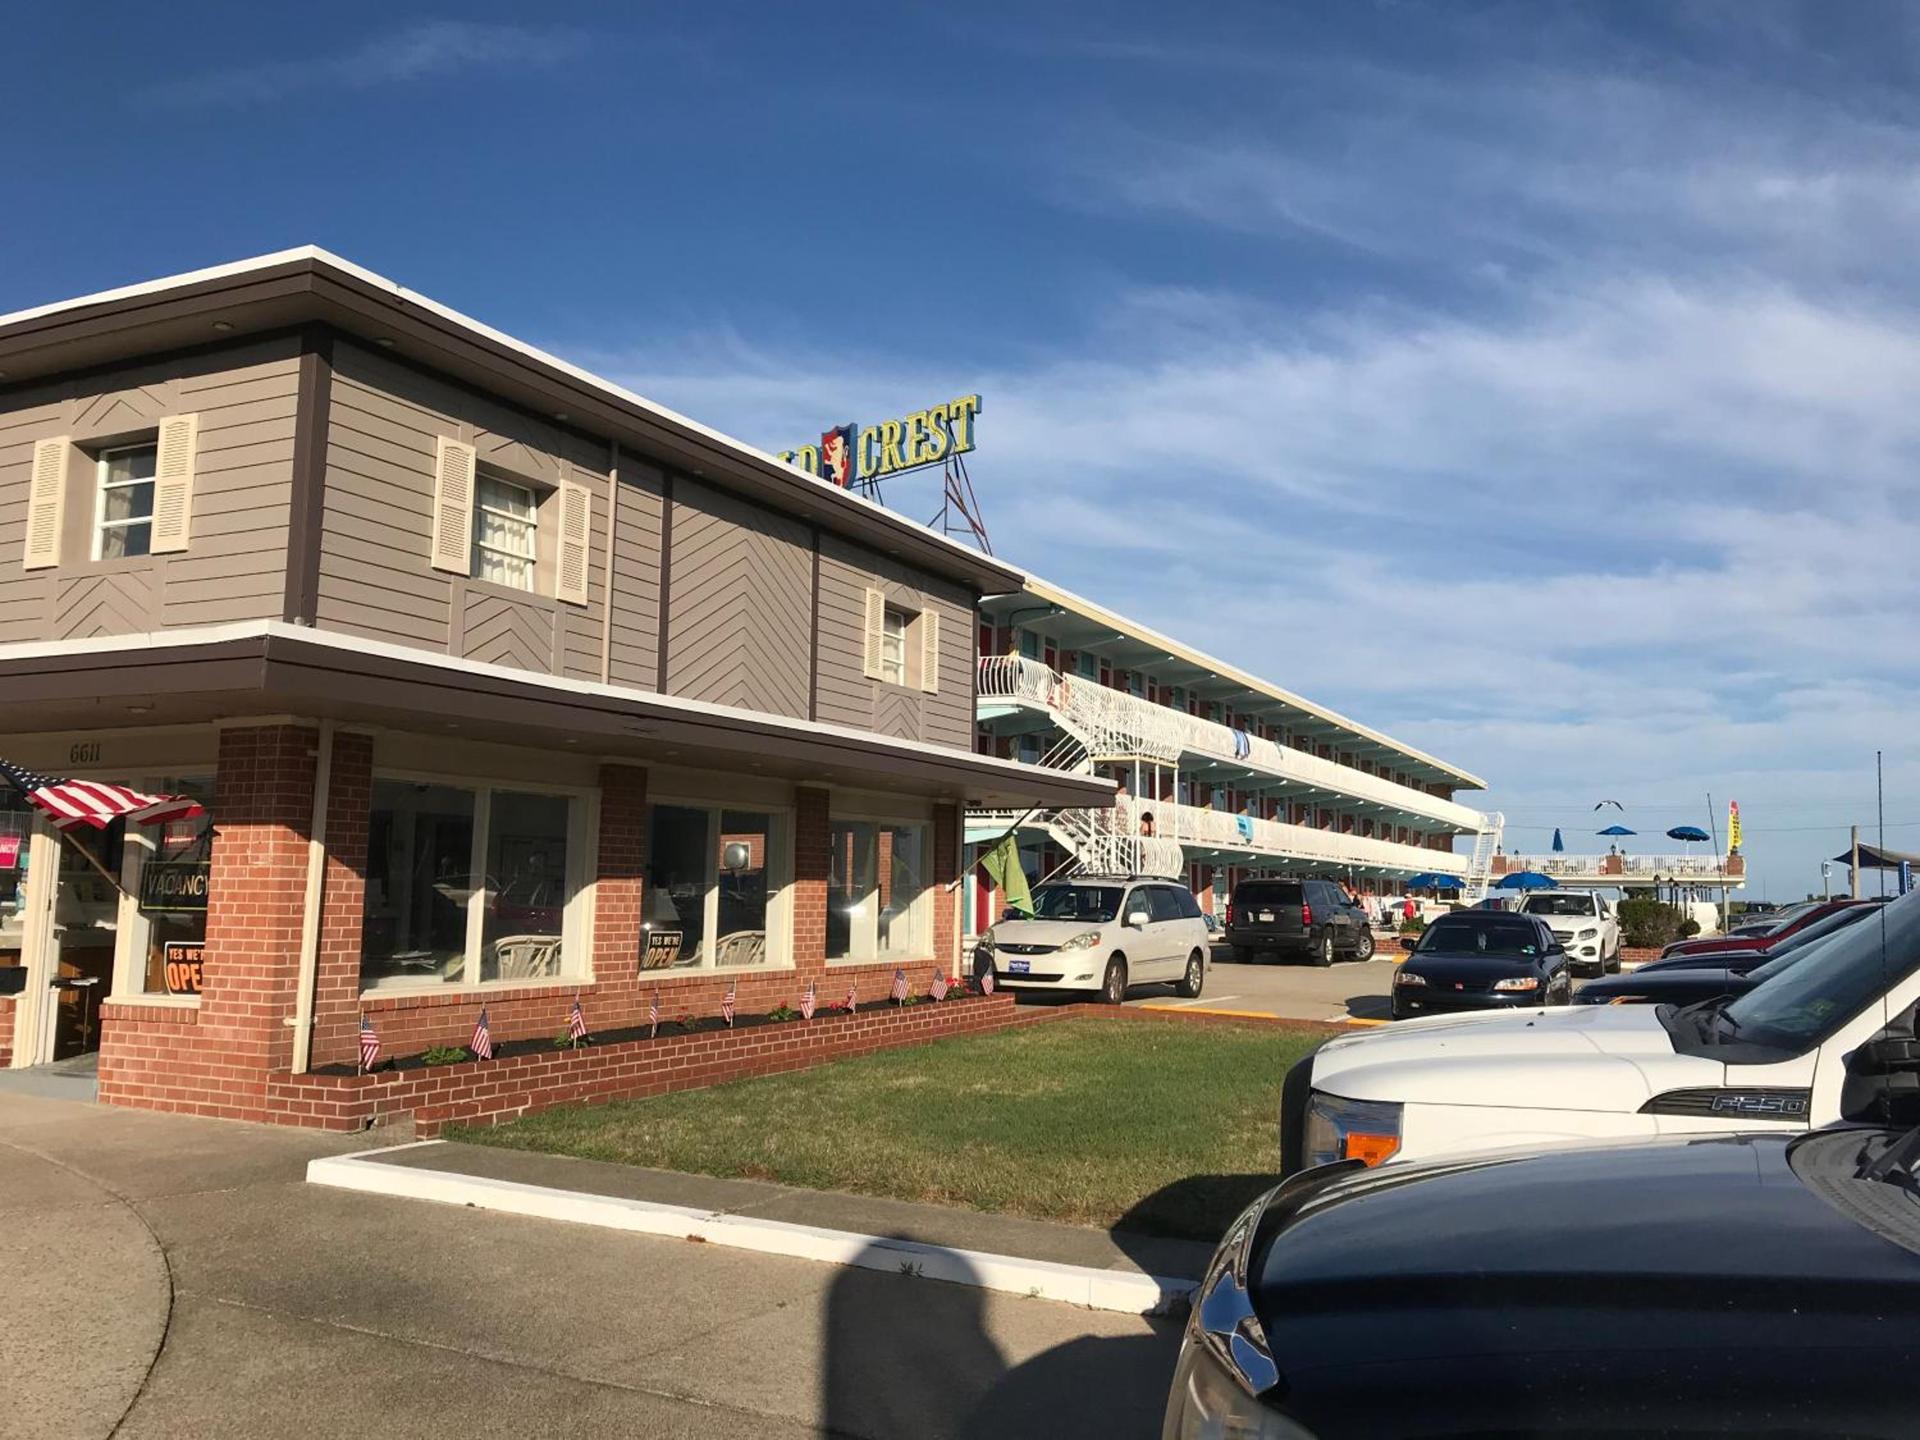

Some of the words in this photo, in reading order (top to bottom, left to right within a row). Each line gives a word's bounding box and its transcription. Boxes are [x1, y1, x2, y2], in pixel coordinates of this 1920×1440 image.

[858, 394, 982, 478] CREST
[70, 743, 102, 763] 6611
[652, 935, 663, 946] YES
[169, 947, 183, 960] YES
[644, 947, 679, 968] OPEN
[167, 962, 203, 991] OPE
